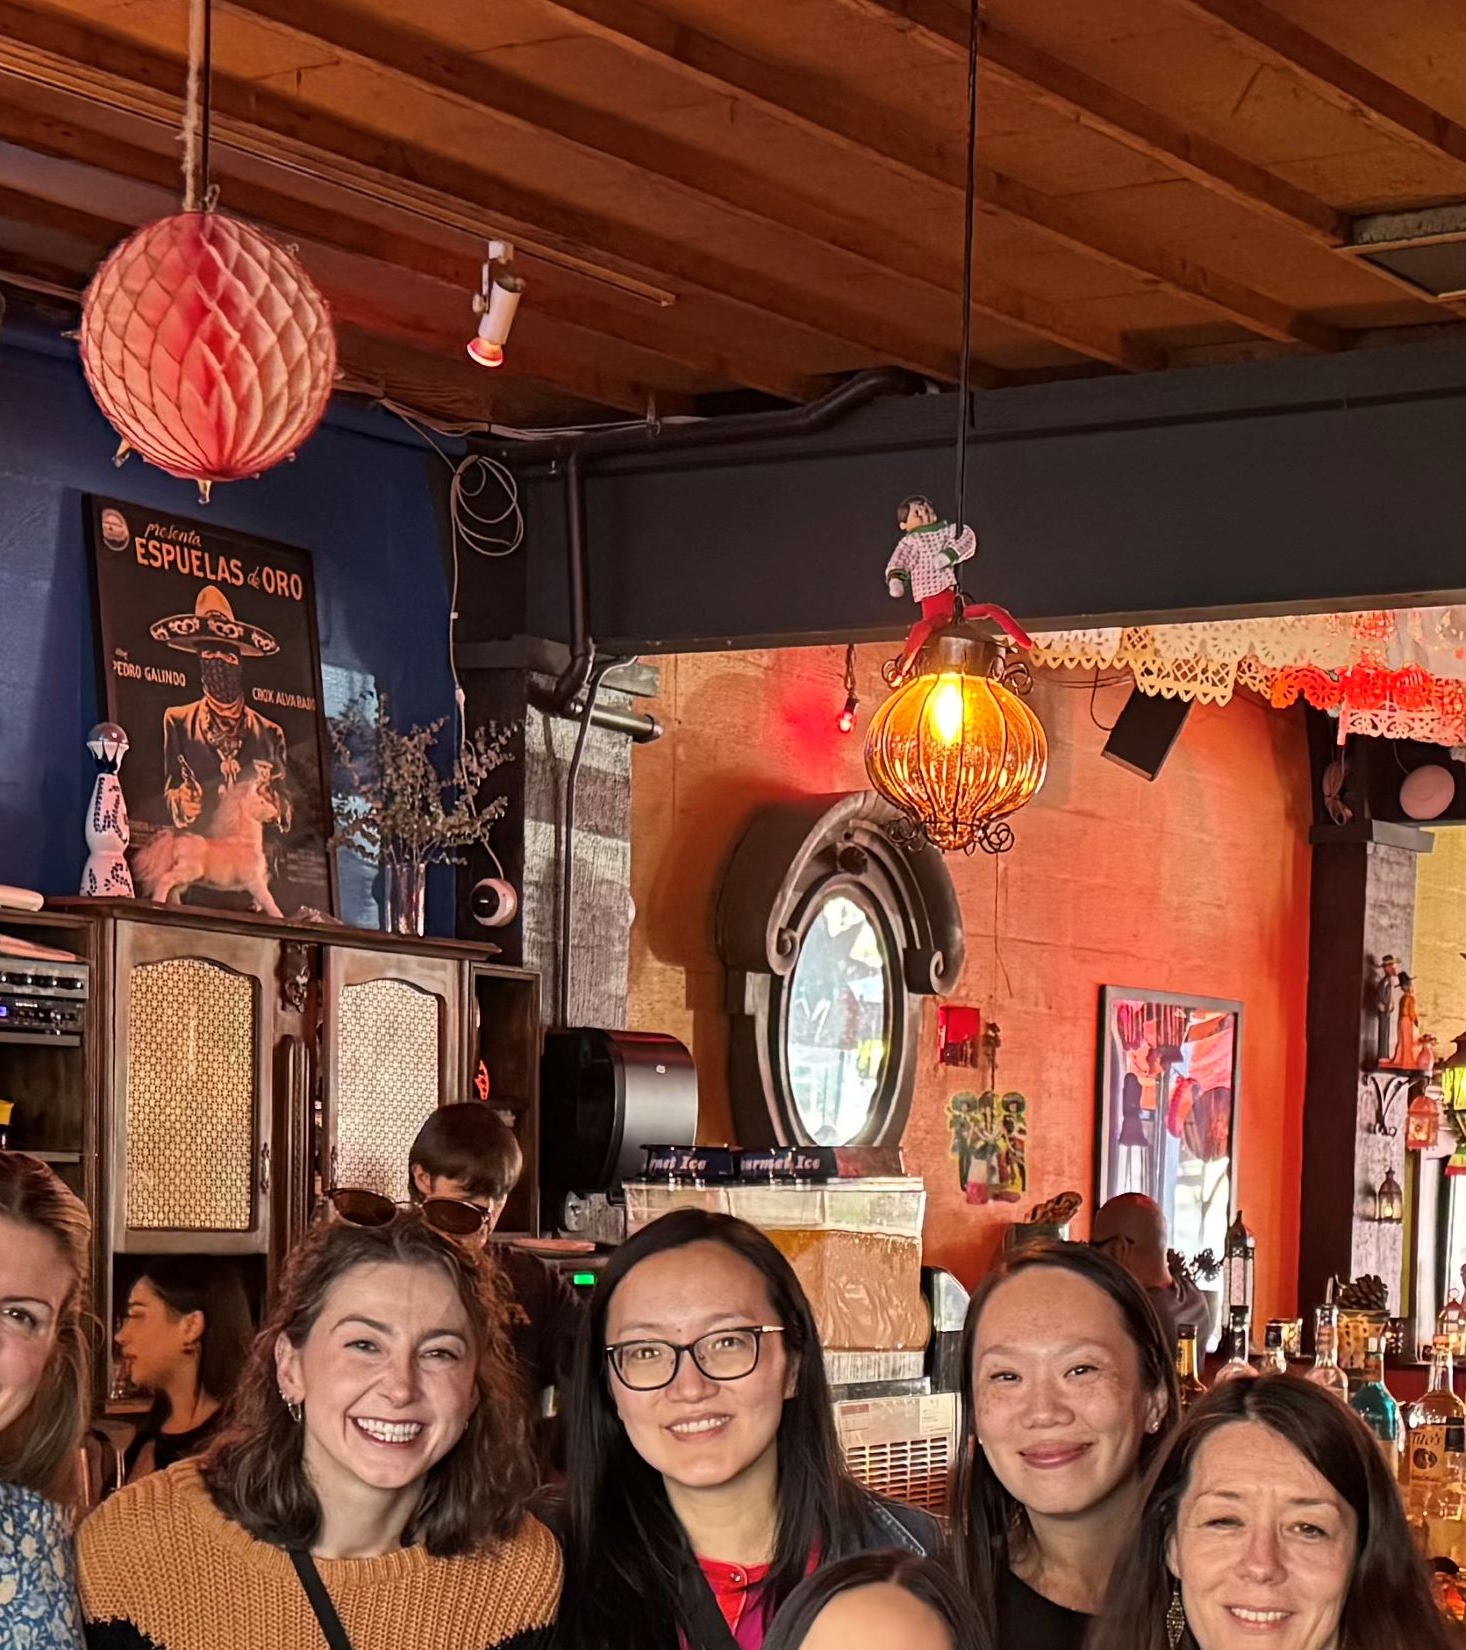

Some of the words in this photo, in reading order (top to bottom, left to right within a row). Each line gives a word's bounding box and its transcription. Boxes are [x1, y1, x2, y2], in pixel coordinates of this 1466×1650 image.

[135, 537, 245, 587] ESPUELAS
[262, 566, 303, 601] ORO
[144, 666, 186, 688] GALINDO
[795, 1155, 821, 1170] Ice
